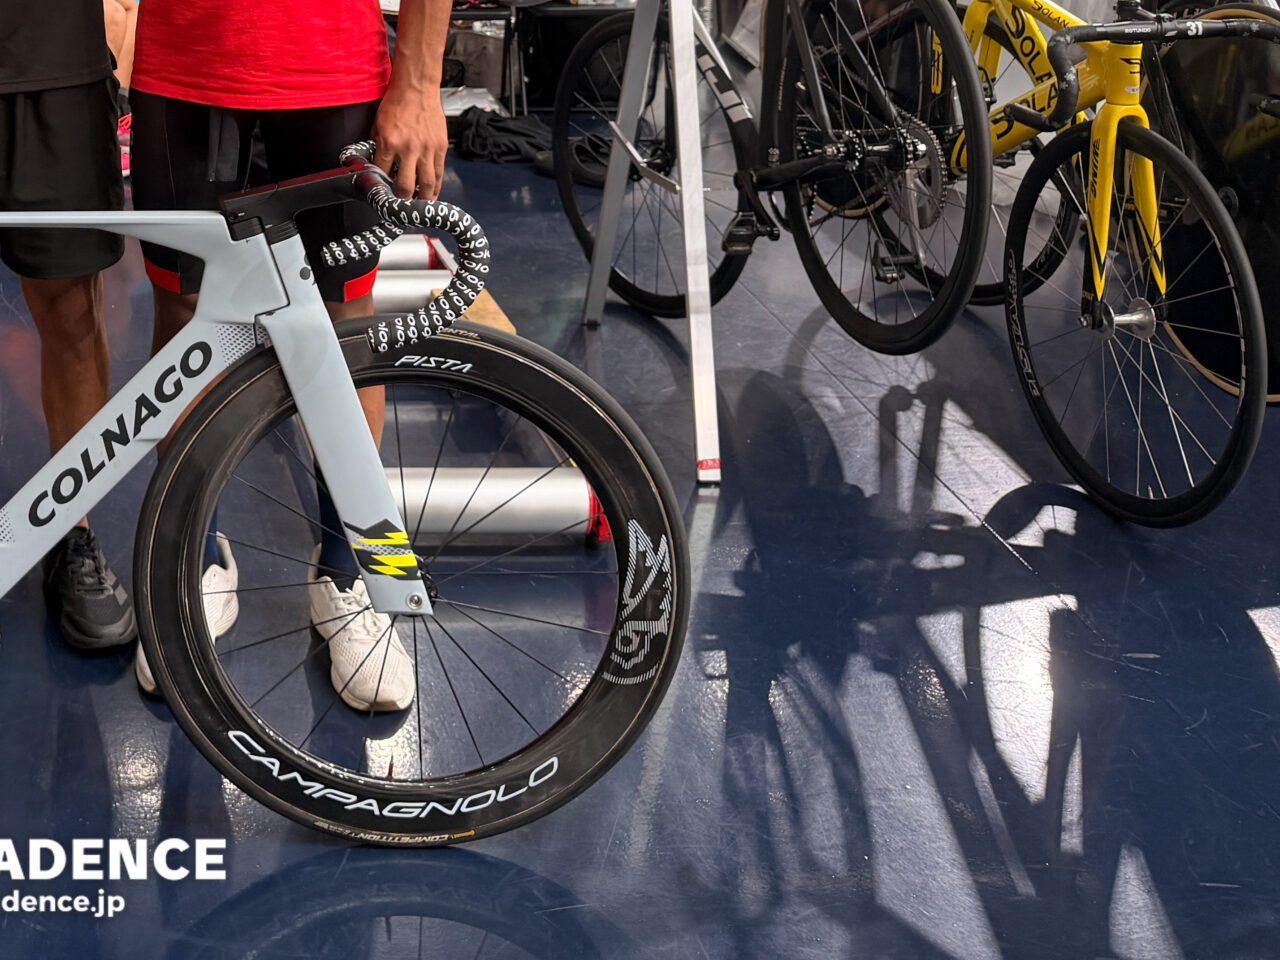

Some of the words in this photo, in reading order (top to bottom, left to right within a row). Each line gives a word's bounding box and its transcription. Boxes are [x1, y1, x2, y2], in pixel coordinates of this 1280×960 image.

[1032, 0, 1070, 29] SOLAN
[1005, 4, 1056, 85] SOLA
[394, 355, 473, 373] PISTA
[28, 341, 213, 528] COLNAGO
[227, 729, 559, 819] CAMPAGNOLO
[357, 830, 450, 844] COMPETITION
